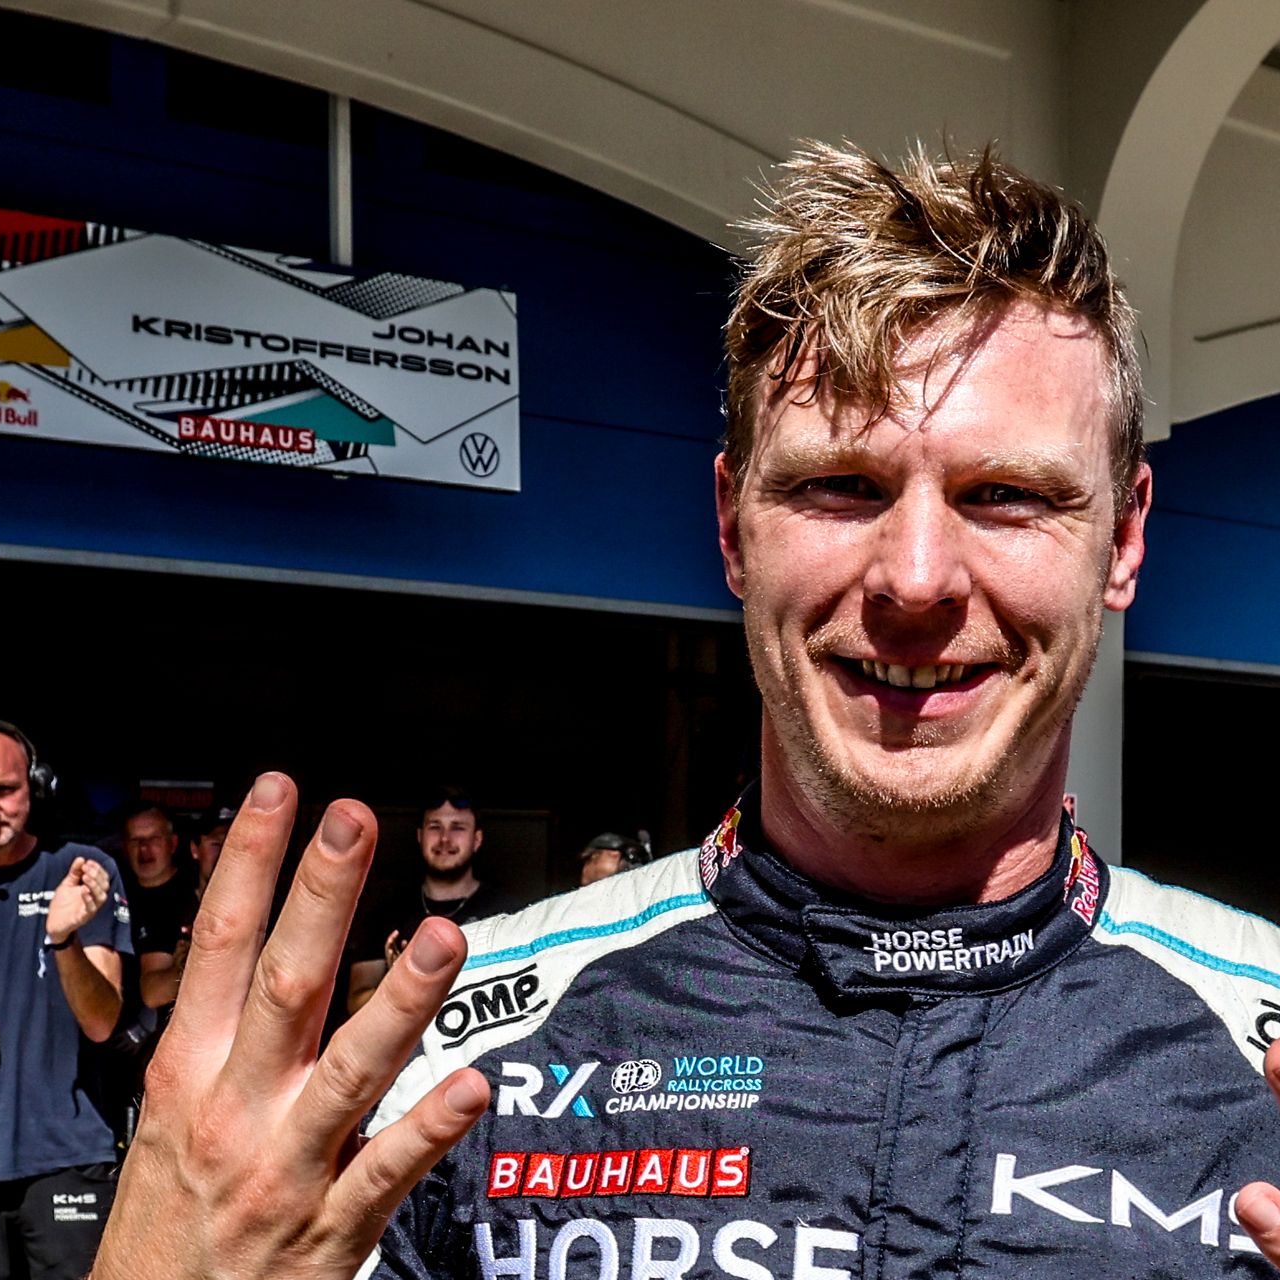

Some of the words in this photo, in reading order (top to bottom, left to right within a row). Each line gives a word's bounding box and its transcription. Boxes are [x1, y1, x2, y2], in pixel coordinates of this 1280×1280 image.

[131, 314, 511, 385] KRISTOFFERSSON
[372, 323, 510, 358] JOHAN
[5, 406, 39, 427] Bull
[179, 417, 314, 452] BAUHAUS
[872, 927, 964, 952] HORSE
[873, 929, 1036, 973] POWERTRAIN
[434, 972, 540, 1039] OMP
[673, 1055, 765, 1078] WORLD
[496, 1061, 601, 1119] RX
[667, 1078, 763, 1093] RALLYCROSS
[604, 1092, 760, 1115] CHAMPIONSHIP
[491, 1153, 746, 1192] BAUHAUS
[53, 1193, 97, 1204] KMS
